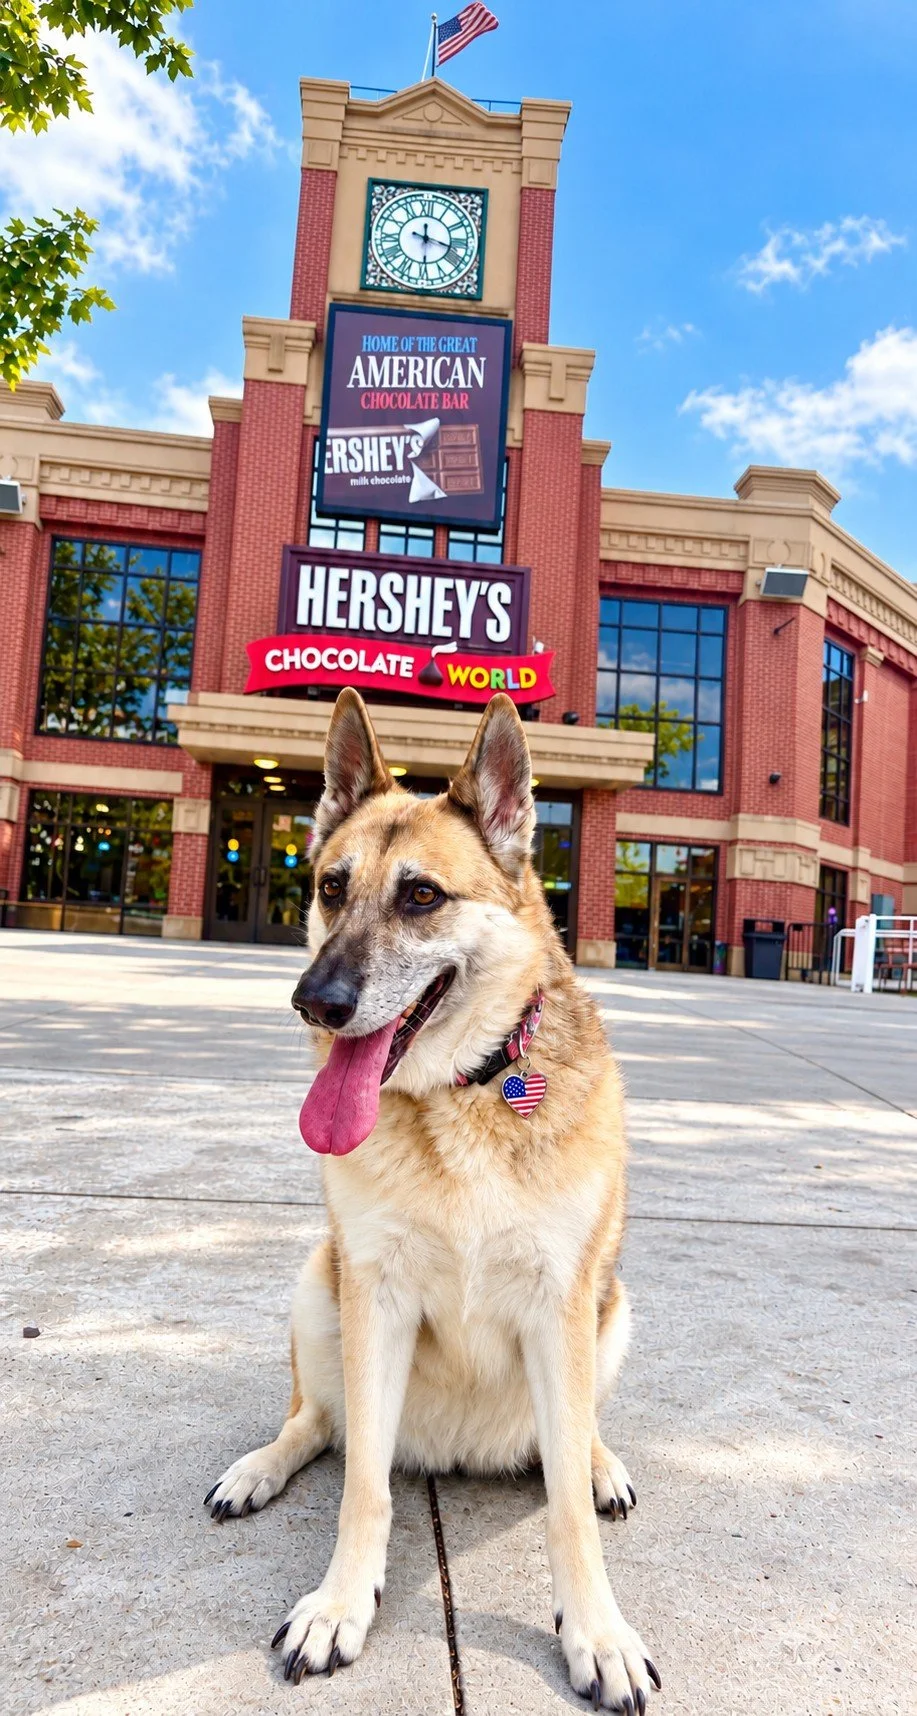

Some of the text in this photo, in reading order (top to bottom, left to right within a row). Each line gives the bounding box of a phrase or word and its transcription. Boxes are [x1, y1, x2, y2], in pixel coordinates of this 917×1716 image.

[362, 335, 478, 353] HOME OF THE GREAT
[346, 355, 486, 389] AMERICAN
[360, 391, 469, 410] CHOCOLATE BAR
[350, 475, 411, 486] milk chocolate
[296, 564, 512, 643] HERSHEY'S
[265, 647, 537, 690] CHOCOLATE WORLD
